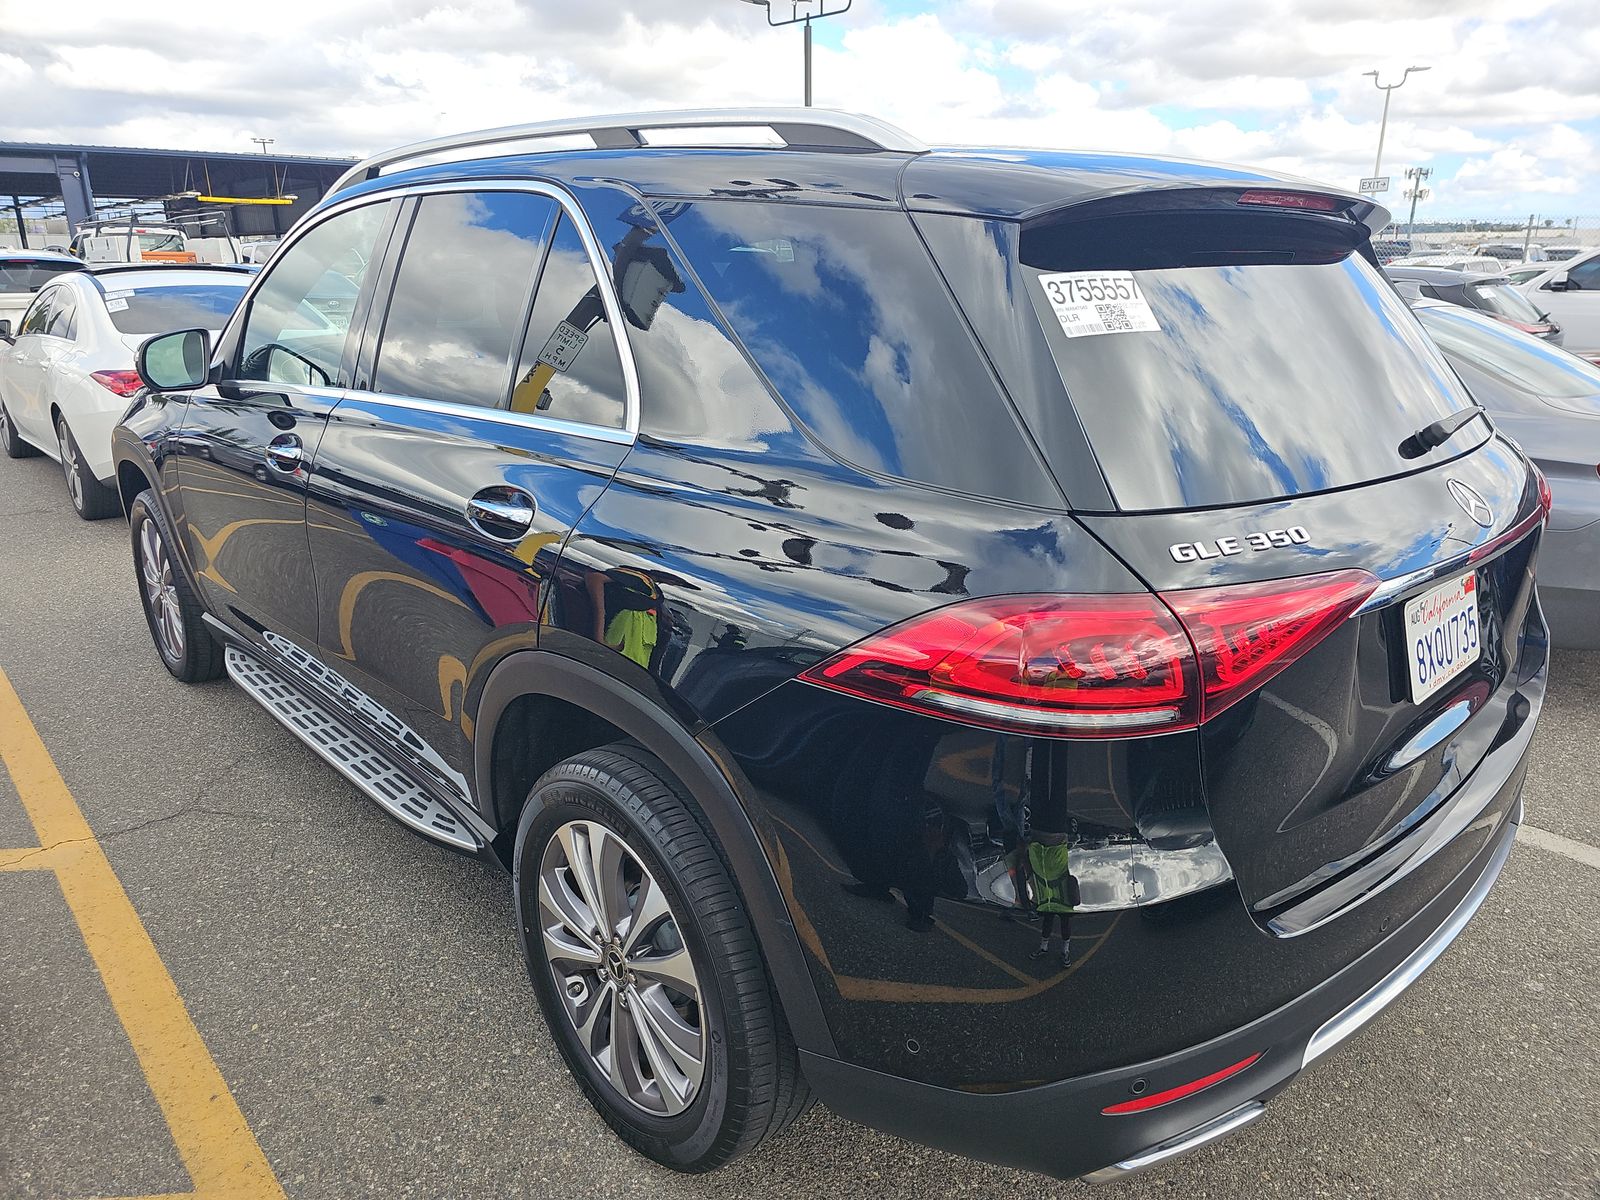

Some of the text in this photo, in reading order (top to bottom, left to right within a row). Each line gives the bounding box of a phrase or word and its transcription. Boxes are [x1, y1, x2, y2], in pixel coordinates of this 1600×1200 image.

[1361, 180, 1380, 190] EXIT
[1047, 278, 1139, 304] 3755557
[1059, 314, 1080, 323] DLR
[1169, 526, 1311, 563] GLE 350
[1416, 605, 1477, 685] 8XQU735
